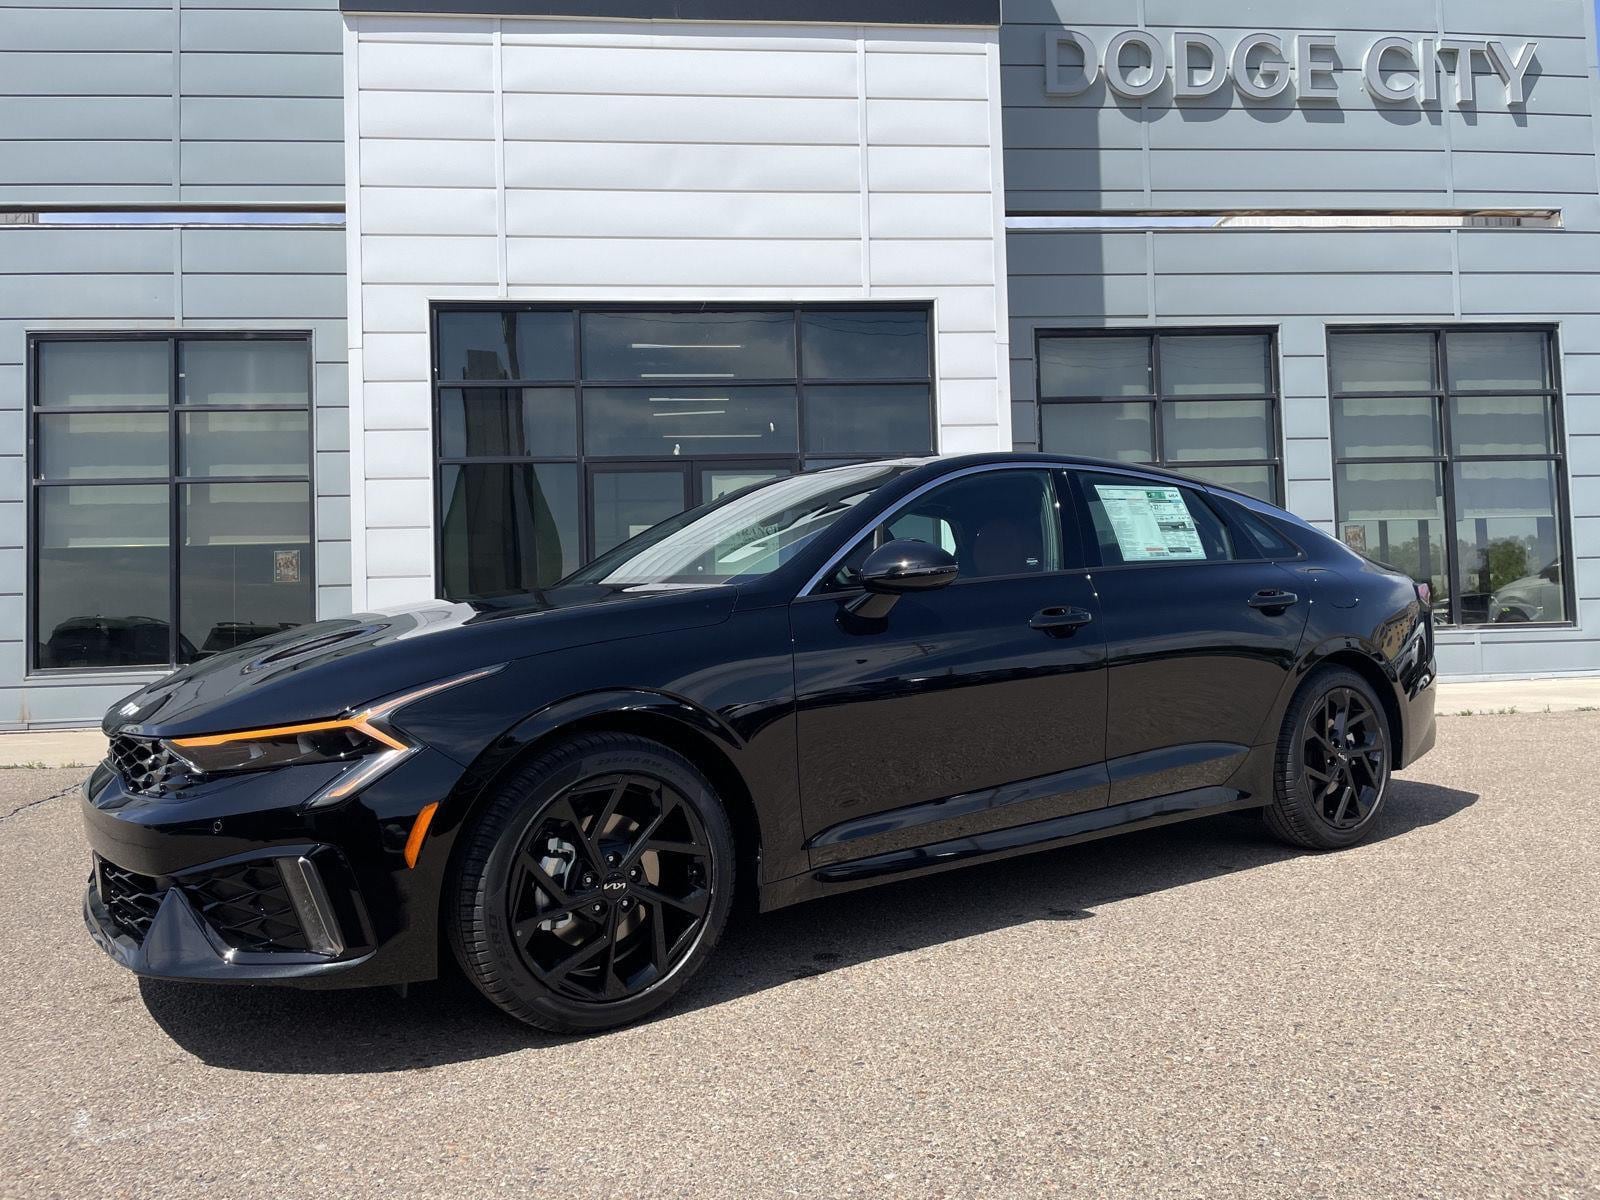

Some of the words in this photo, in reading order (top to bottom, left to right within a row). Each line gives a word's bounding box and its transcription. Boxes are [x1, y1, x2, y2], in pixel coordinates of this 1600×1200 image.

[1044, 30, 1340, 98] DODGE
[1362, 35, 1538, 104] CITY
[603, 882, 627, 890] KIA
